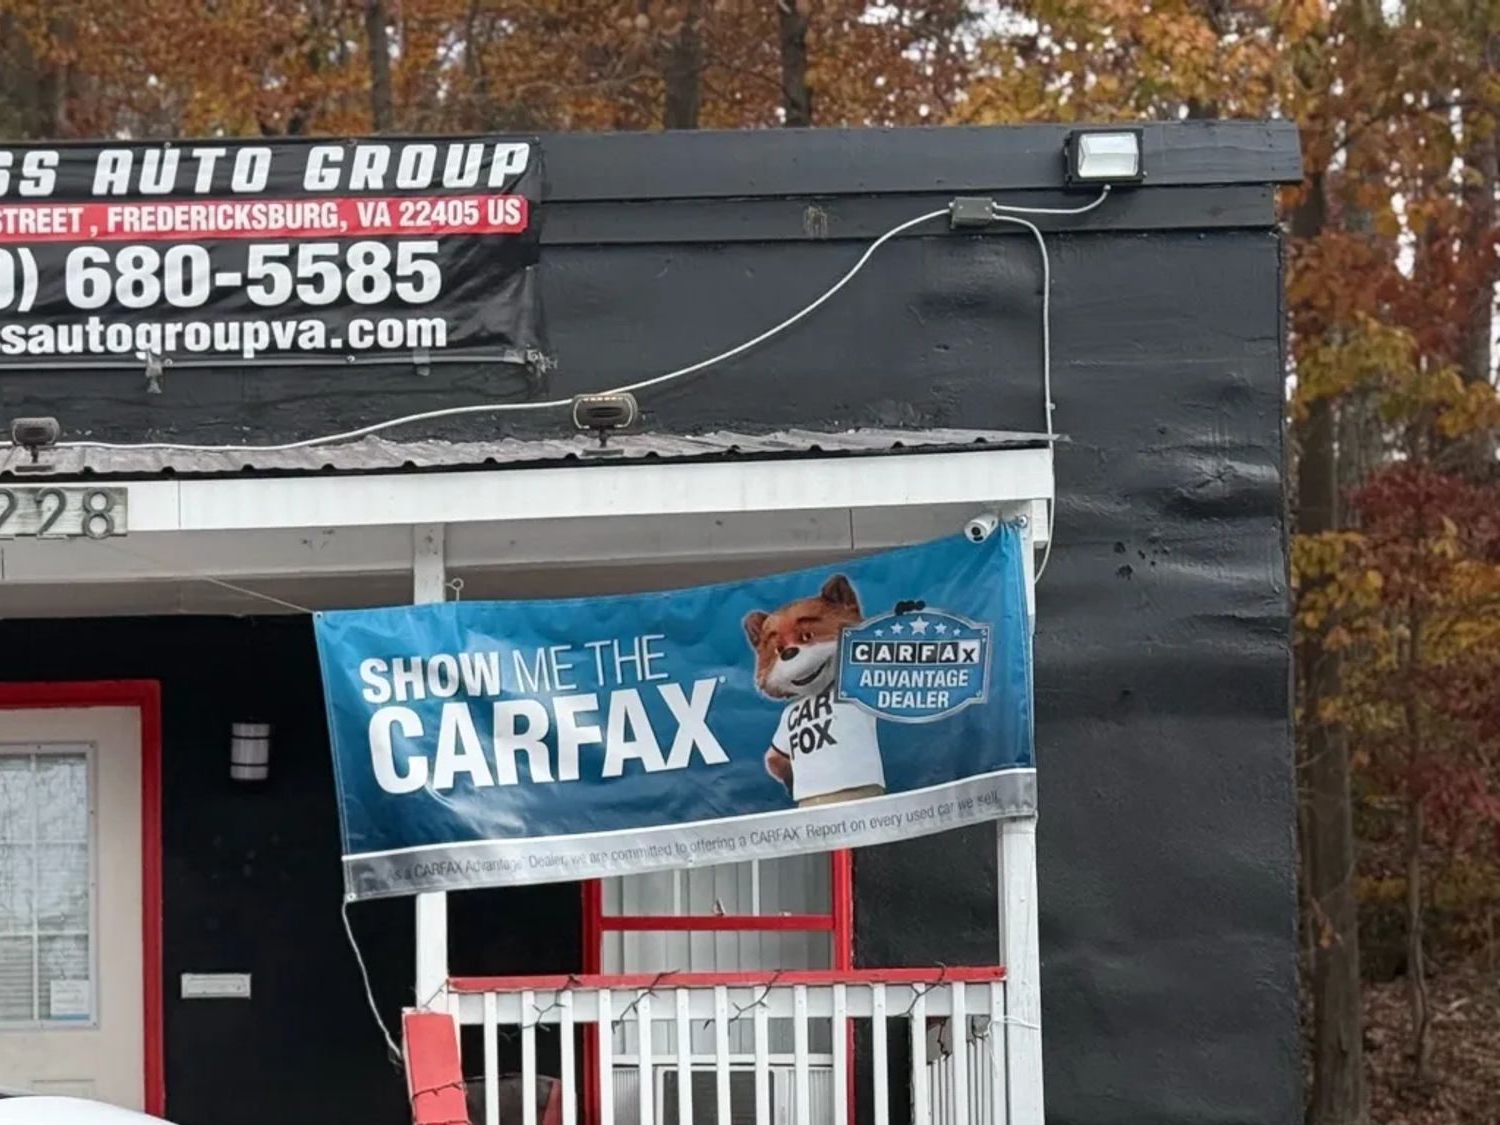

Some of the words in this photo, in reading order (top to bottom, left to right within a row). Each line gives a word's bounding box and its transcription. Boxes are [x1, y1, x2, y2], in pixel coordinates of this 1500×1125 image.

[92, 147, 273, 195] AUTO
[303, 142, 531, 192] GROUP
[107, 200, 349, 234] FREDERICKSBURG,
[357, 201, 392, 228] VA
[399, 199, 480, 228] 22405
[487, 198, 522, 226] US
[65, 240, 444, 310] 680-5585
[359, 650, 501, 703] SHOW
[512, 644, 578, 694] ME
[584, 633, 669, 688] THE
[850, 643, 978, 664] CARFAX
[859, 668, 970, 688] ADVANTAGE
[877, 690, 950, 709] DEALER
[787, 689, 834, 733] CAR
[368, 676, 731, 795] CARFAX
[789, 719, 838, 761] FOX
[414, 861, 464, 879] CARFAX
[611, 844, 672, 862] committed
[675, 841, 687, 854] to
[690, 833, 736, 851] offering
[739, 835, 747, 847] a
[805, 821, 847, 840] Report
[850, 818, 866, 832] on
[869, 813, 903, 831] every
[906, 804, 935, 823] used
[938, 799, 954, 814] car
[958, 797, 974, 810] we
